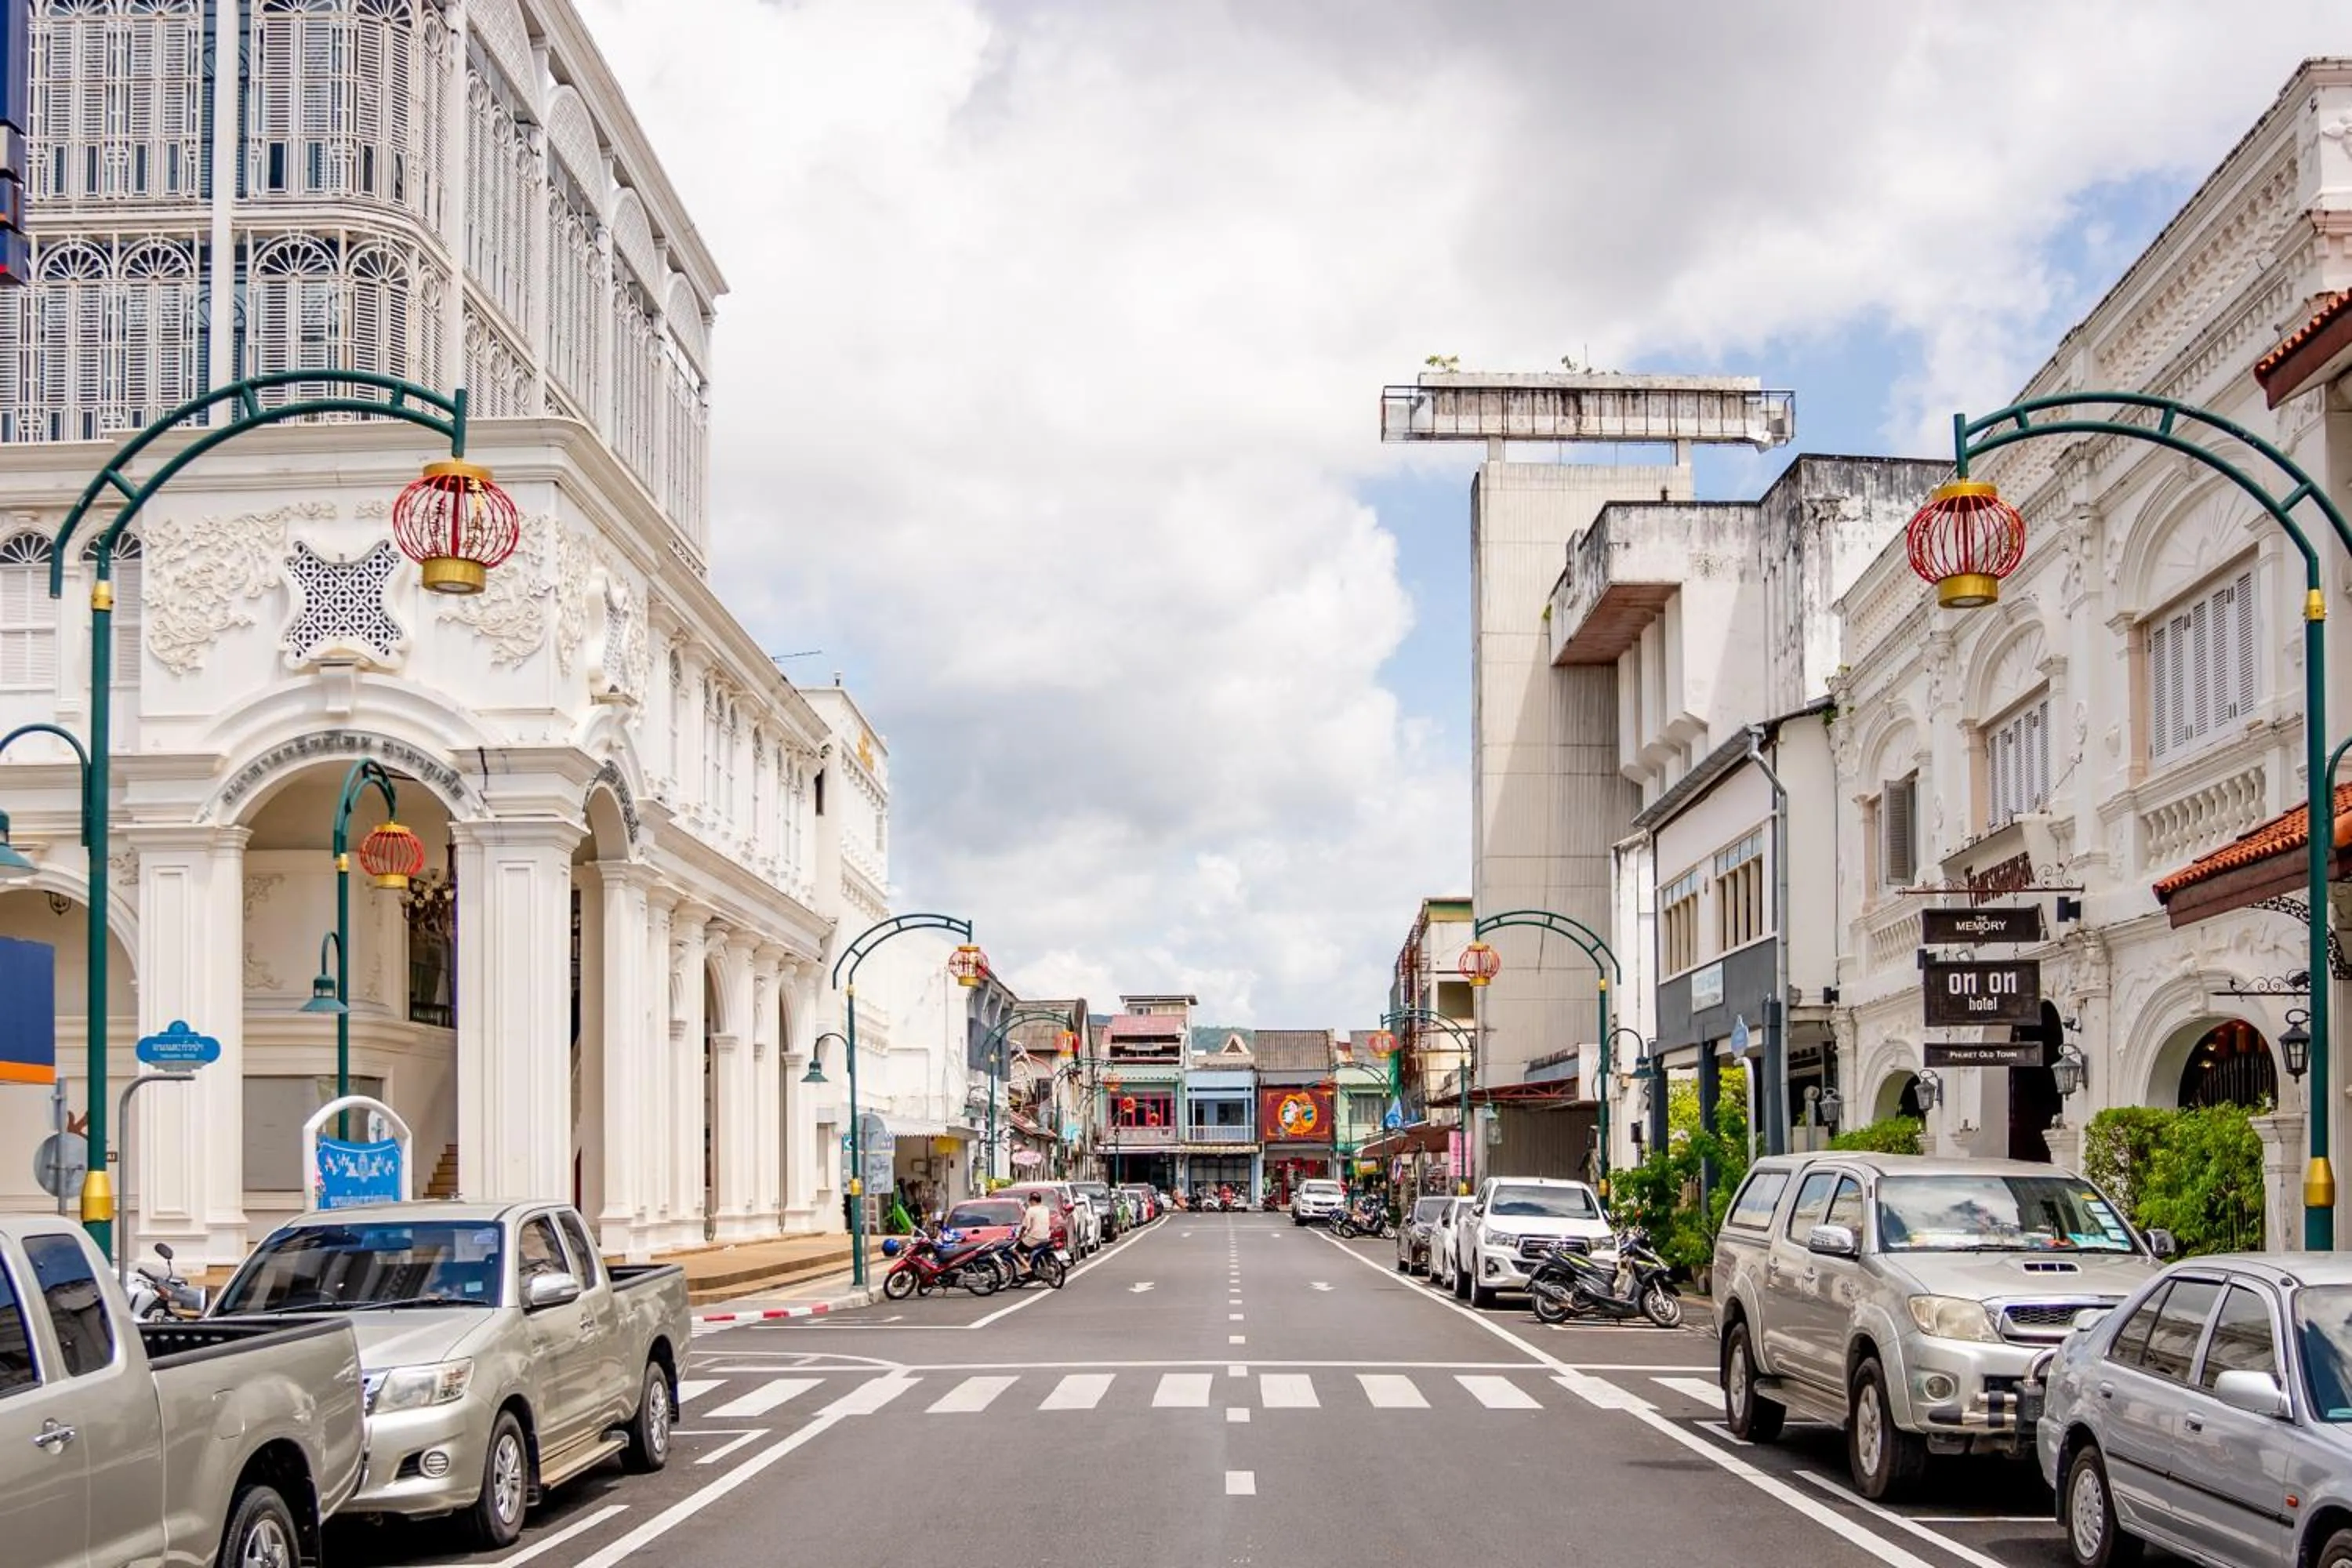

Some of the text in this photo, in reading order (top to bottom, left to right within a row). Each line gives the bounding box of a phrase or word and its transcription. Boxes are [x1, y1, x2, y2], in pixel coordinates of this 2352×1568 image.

[1955, 920, 2007, 931] MEMORY
[1948, 971, 2016, 994] on on
[1969, 996, 1998, 1011] hotel
